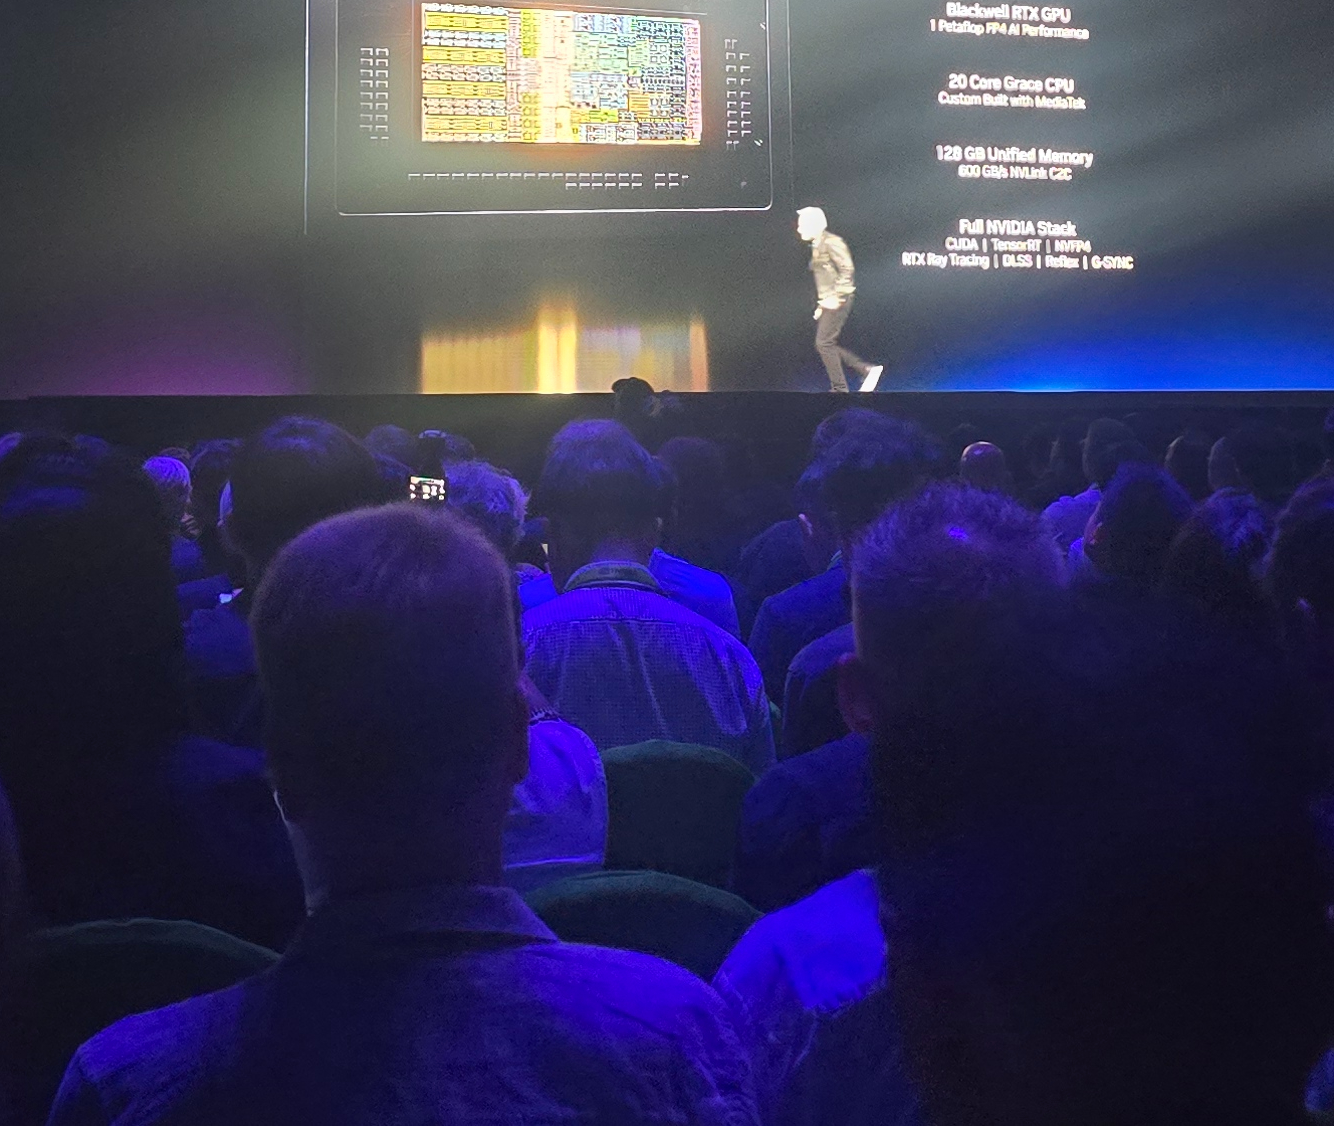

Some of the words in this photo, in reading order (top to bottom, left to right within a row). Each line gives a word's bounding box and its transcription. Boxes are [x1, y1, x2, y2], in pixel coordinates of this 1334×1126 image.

[946, 2, 1010, 20] Blackwell
[1012, 5, 1040, 22] RTX
[1041, 7, 1071, 23] GPU
[930, 19, 936, 31] 1
[938, 20, 984, 35] Petaflop
[986, 22, 1007, 35] FP4
[1008, 23, 1020, 35] AI
[1022, 24, 1089, 39] Performance
[948, 74, 968, 90] 20
[969, 75, 1001, 91] Core
[1004, 76, 1043, 93] Grace
[1045, 77, 1074, 94] CPU
[938, 91, 981, 106] Custom
[983, 93, 1008, 107] Built
[1010, 94, 1034, 108] with
[1035, 94, 1087, 110] MediaTek
[936, 145, 962, 161] 128
[964, 146, 985, 162] GB
[987, 147, 1036, 164] Unified
[1038, 149, 1094, 169] Memory
[982, 165, 1008, 179] GB/s
[1010, 166, 1048, 180] NVLink
[1049, 167, 1072, 180] C2C
[959, 219, 984, 234] Full
[986, 219, 1036, 236] NVIDIA
[1036, 221, 1077, 236] Stack
[945, 237, 978, 251] CUDA
[990, 237, 1042, 252] TensorRT
[1055, 239, 1092, 253] NVFP4
[901, 252, 926, 266] RTX
[927, 252, 948, 267] Ray
[949, 253, 990, 269] Tracing
[1002, 254, 1033, 268] DLSS
[1045, 255, 1079, 269] Reflex
[1091, 255, 1134, 270] G-SYNC
